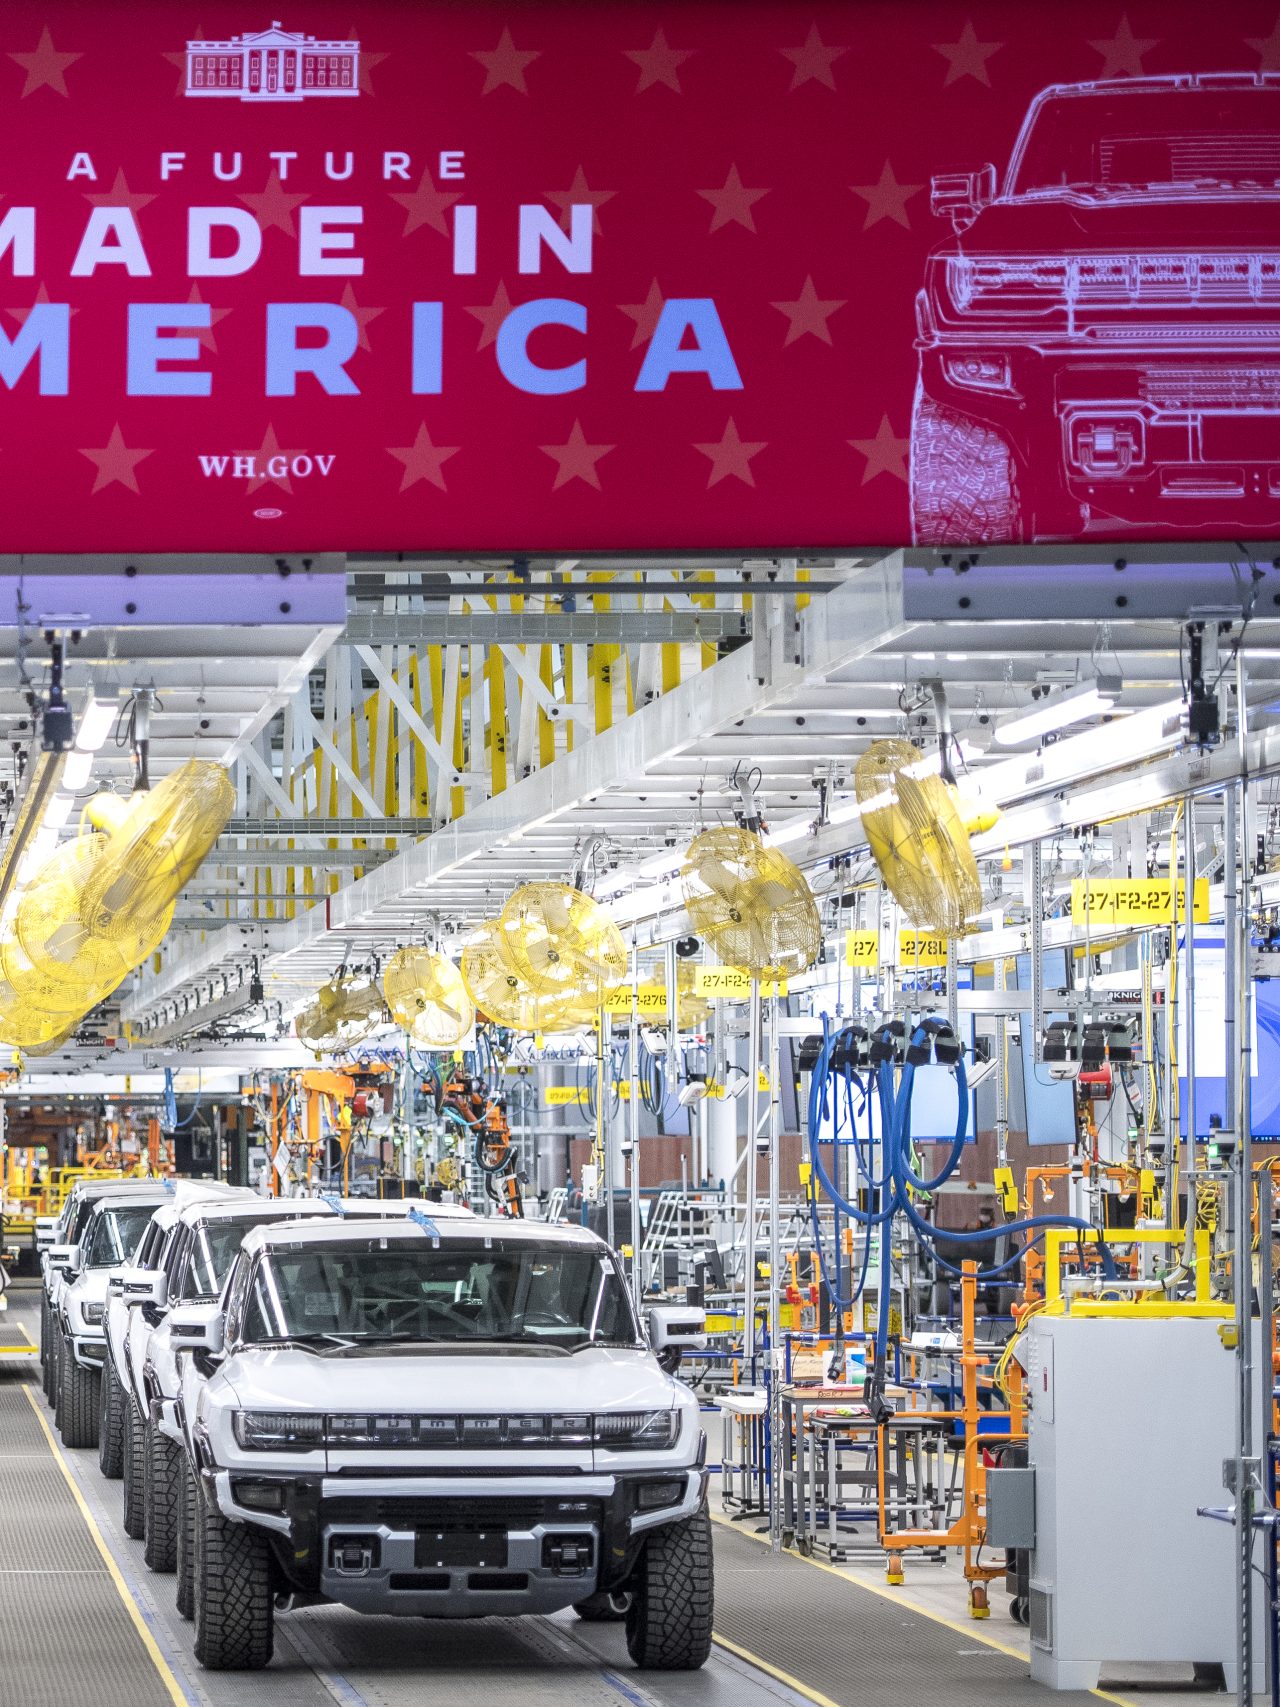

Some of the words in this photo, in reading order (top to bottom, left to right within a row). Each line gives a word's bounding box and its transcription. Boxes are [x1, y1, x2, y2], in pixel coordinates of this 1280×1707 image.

[67, 152, 97, 180] A
[160, 151, 466, 181] FUTURE
[453, 204, 593, 275] IN
[198, 455, 336, 479] WH.GOV
[343, 1419, 576, 1428] HUMMER
